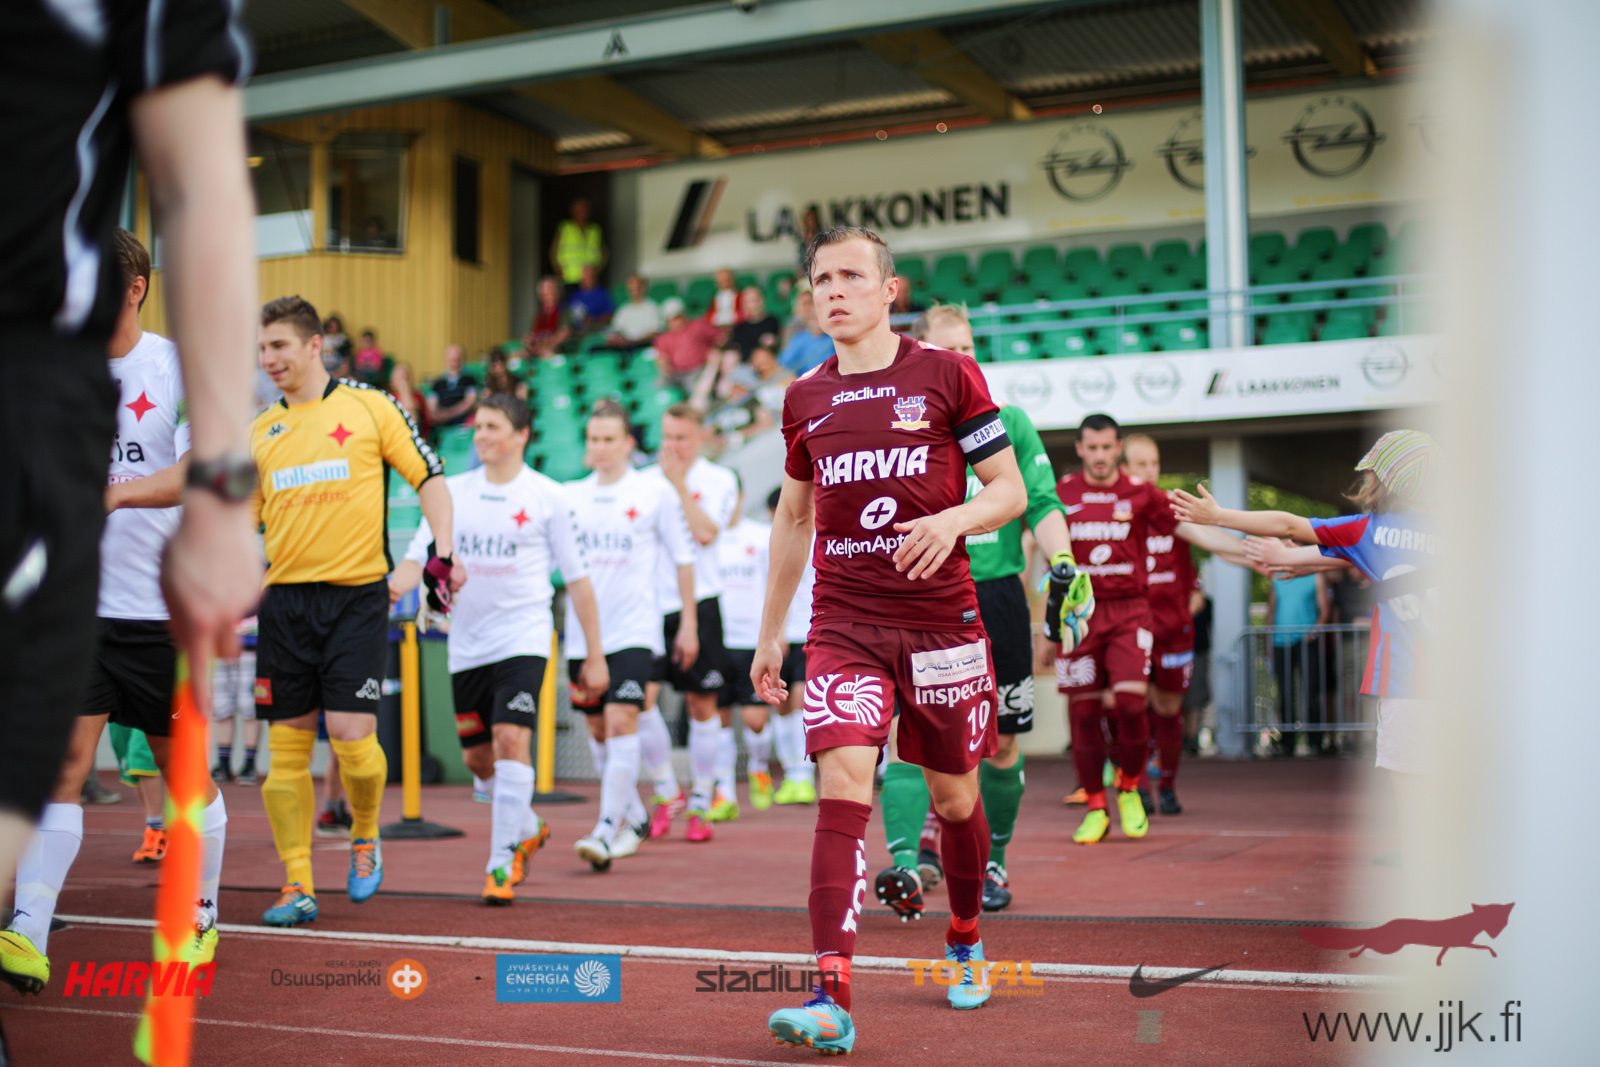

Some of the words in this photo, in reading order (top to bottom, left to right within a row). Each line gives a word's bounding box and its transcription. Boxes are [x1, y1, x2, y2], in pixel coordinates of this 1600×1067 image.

[832, 386, 896, 406] stadium
[273, 465, 347, 489] Folksam
[818, 445, 929, 485] HARVIA
[459, 534, 517, 557] Aktia
[1373, 525, 1440, 555] KORHO
[915, 676, 993, 708] Inspecta
[967, 700, 991, 736] 10
